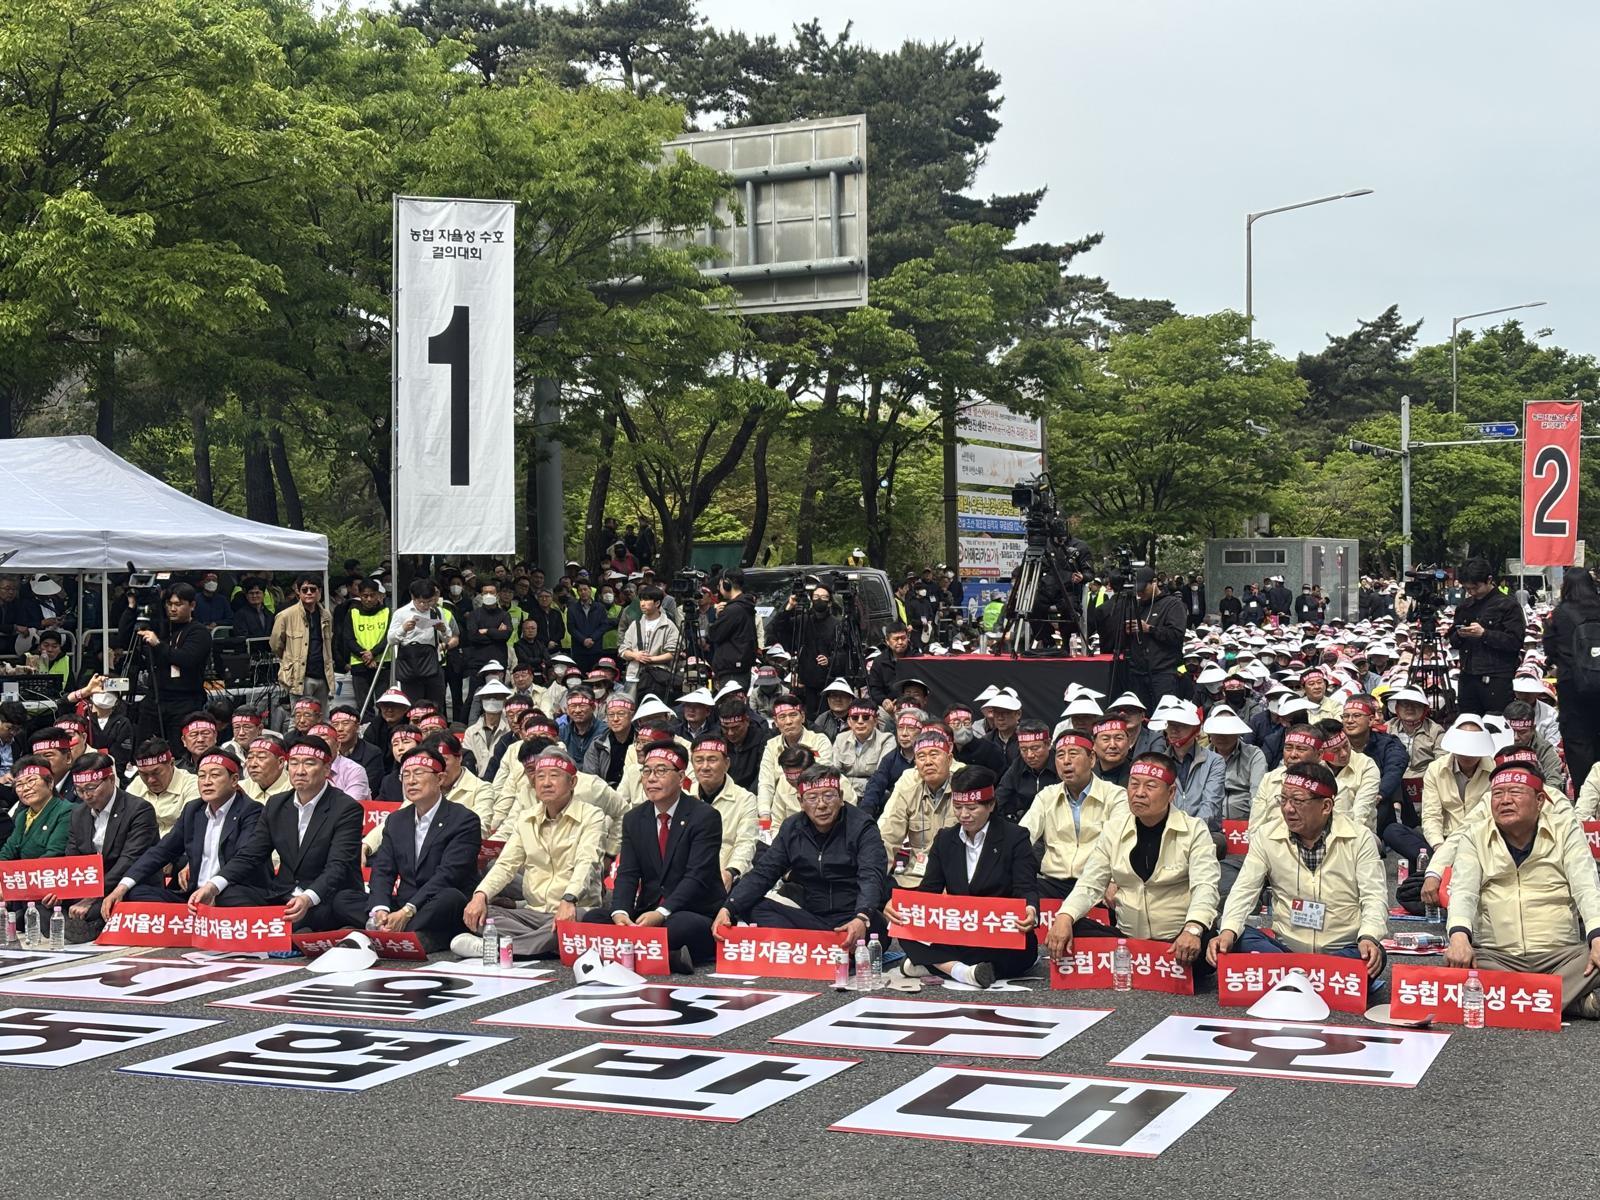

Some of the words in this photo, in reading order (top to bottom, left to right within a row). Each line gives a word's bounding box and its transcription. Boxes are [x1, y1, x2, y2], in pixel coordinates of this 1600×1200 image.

[410, 228, 434, 243] 농협
[438, 228, 476, 244] 자율성
[479, 230, 505, 244] 수호
[432, 246, 482, 261] 결의대회
[428, 305, 470, 486] 1
[1533, 445, 1571, 537] 2
[3, 870, 27, 890] 농협
[29, 867, 69, 888] 자율성
[71, 866, 99, 884] 수호
[1295, 900, 1301, 909] 7
[123, 915, 165, 935] 자율성
[209, 919, 247, 939] 자율성
[251, 917, 286, 938] 수호
[898, 902, 925, 927] 농협
[928, 906, 978, 931] 자율성
[982, 910, 1019, 934] 수호
[563, 933, 586, 955] 농협
[634, 938, 664, 960] 수호
[723, 939, 755, 961] 농협
[759, 941, 806, 964] 자율성
[811, 944, 846, 965] 수호
[1056, 951, 1092, 975] 농협
[1155, 957, 1187, 980] 수호
[1225, 967, 1263, 992] 농협
[1329, 974, 1361, 997] 수호
[1398, 980, 1438, 1006] 농협
[1443, 984, 1505, 1010] 자성
[1510, 987, 1554, 1013] 수호
